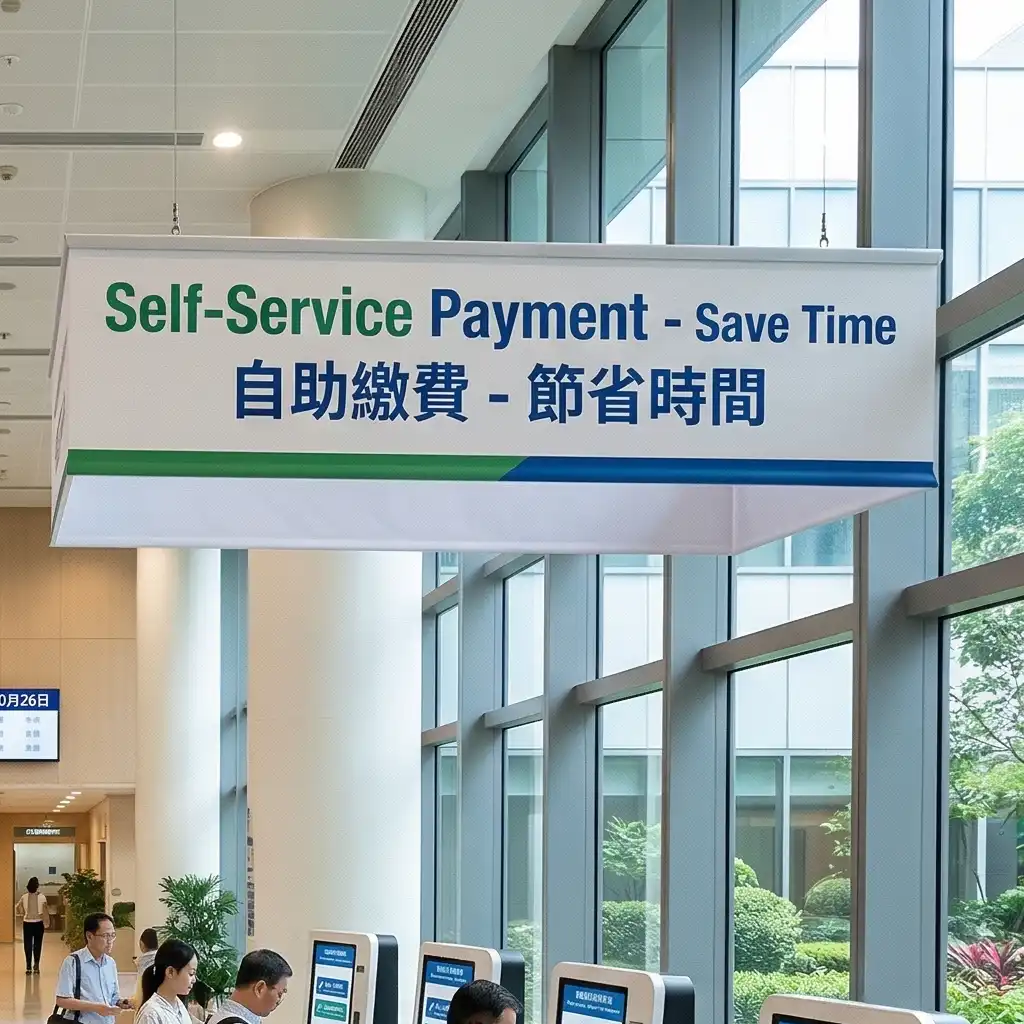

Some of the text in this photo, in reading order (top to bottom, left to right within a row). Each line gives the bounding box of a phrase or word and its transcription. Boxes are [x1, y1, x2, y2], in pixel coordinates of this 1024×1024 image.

[105, 281, 413, 338] Self-Service
[431, 288, 649, 350] Payment
[695, 302, 790, 344] Save
[801, 304, 897, 346] Time
[235, 358, 469, 423] 自助繳費
[526, 362, 766, 427] 節省時間
